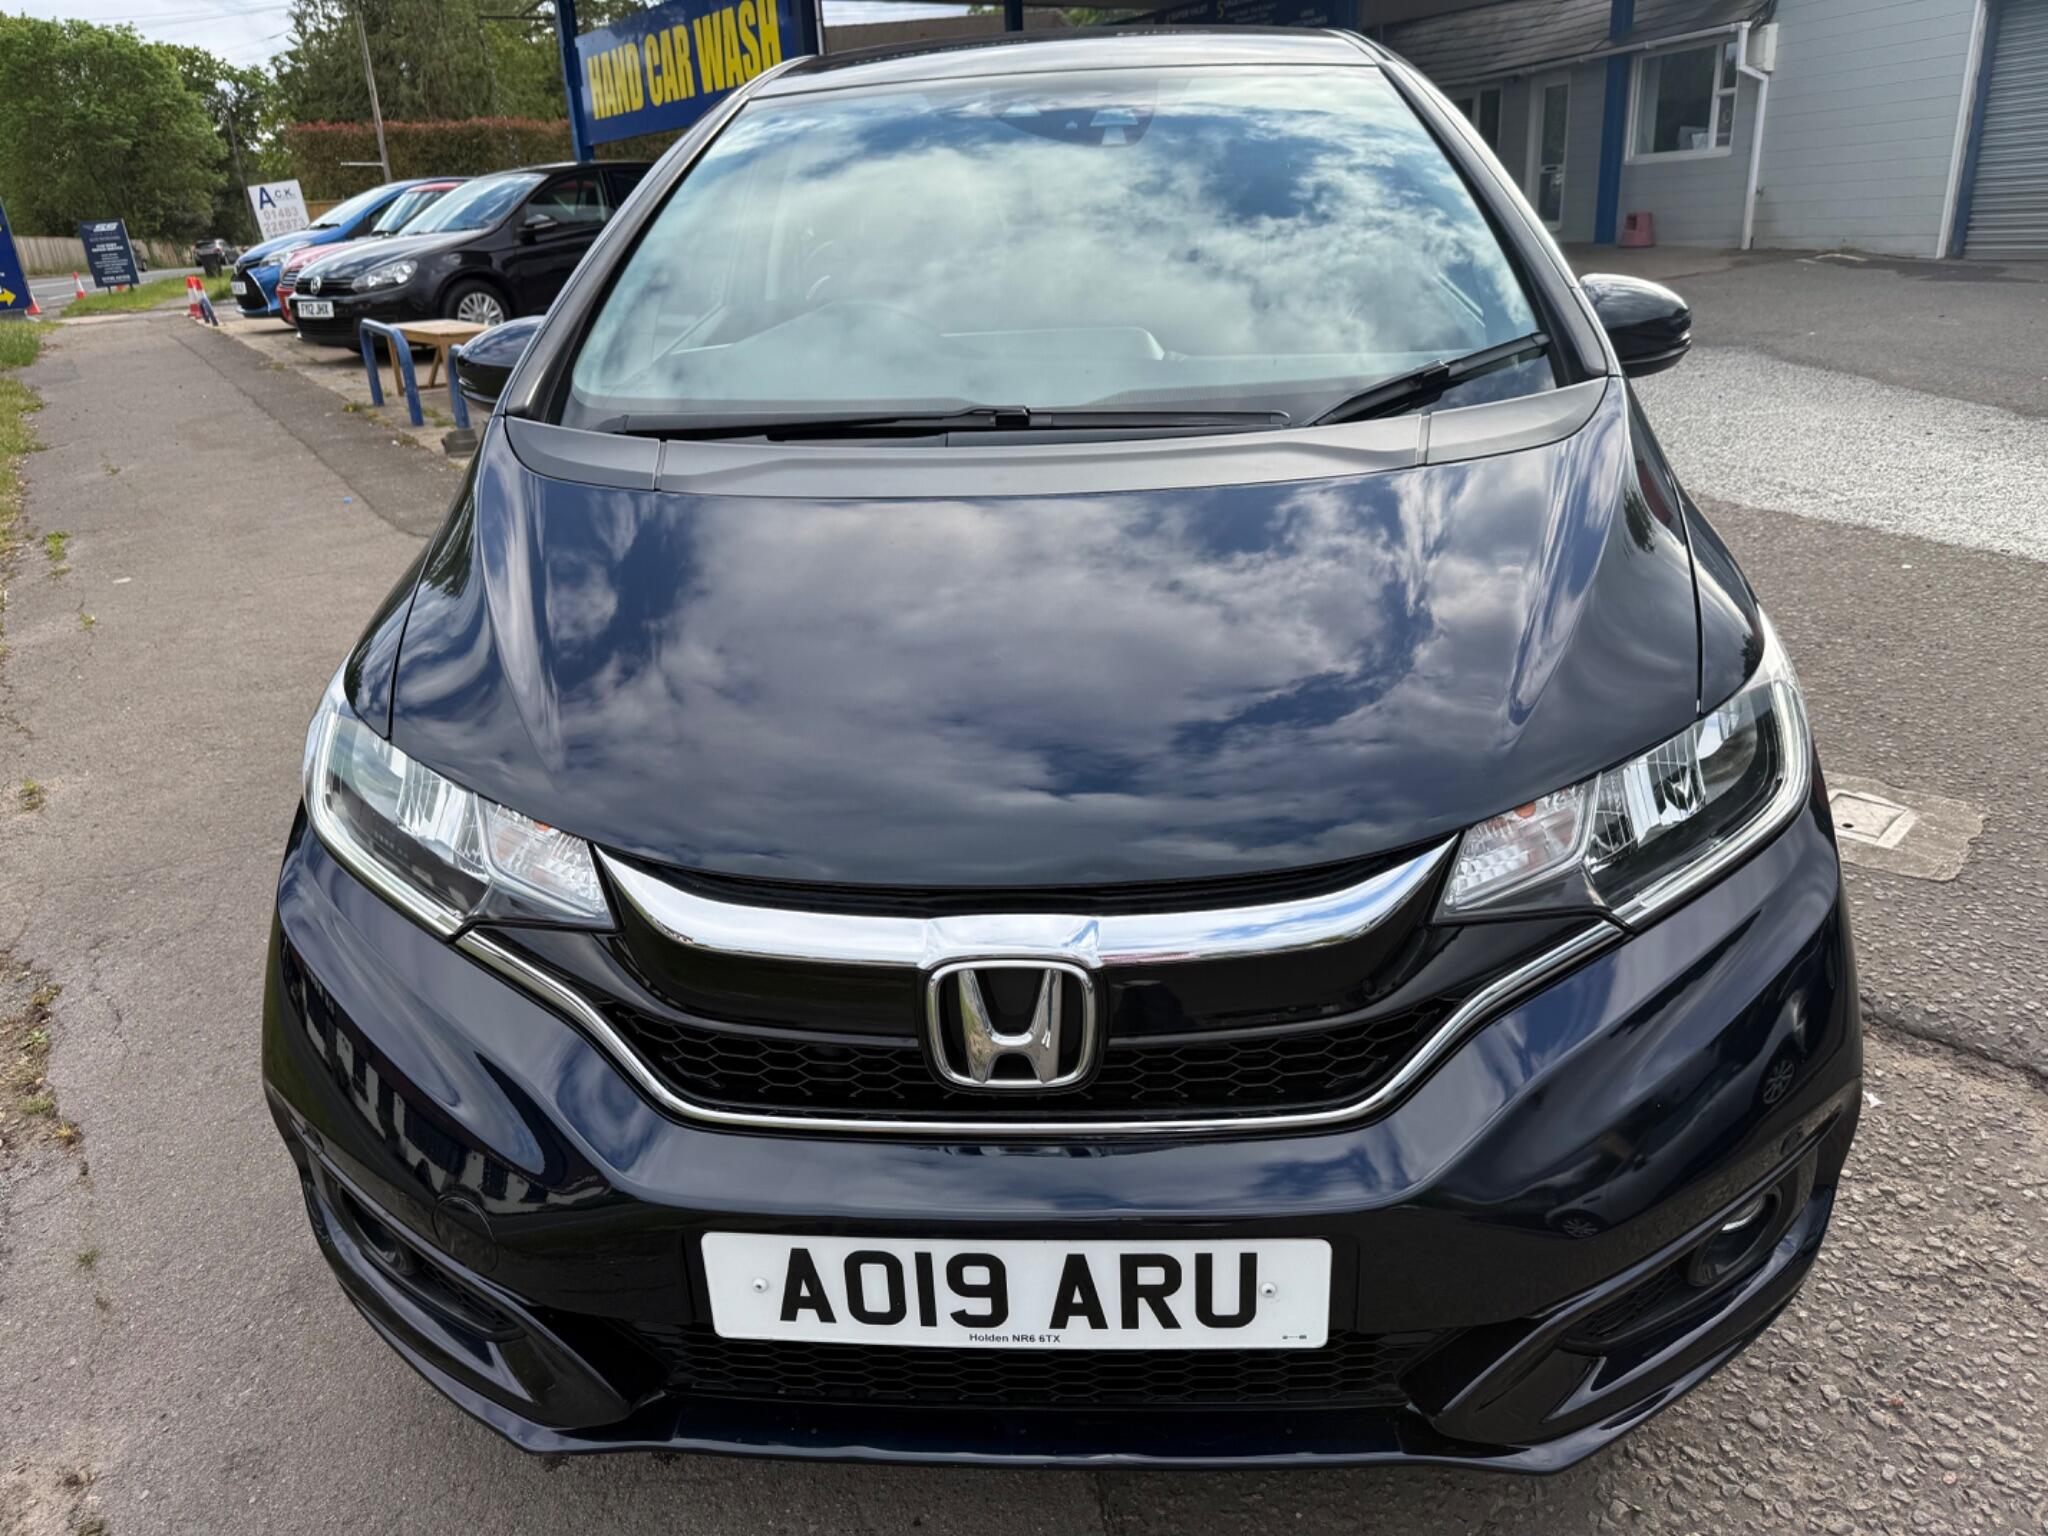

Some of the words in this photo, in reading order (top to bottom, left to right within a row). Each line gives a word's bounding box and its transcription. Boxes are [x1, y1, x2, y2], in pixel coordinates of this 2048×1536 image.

[587, 42, 645, 120] HAND
[644, 24, 696, 107] CAR
[693, 0, 782, 94] WASH
[779, 1247, 1009, 1329] AO19
[1049, 1253, 1258, 1330] ARU
[969, 1333, 1009, 1342] Holden
[1012, 1334, 1036, 1343] NR6
[1039, 1334, 1061, 1343] 6TX
